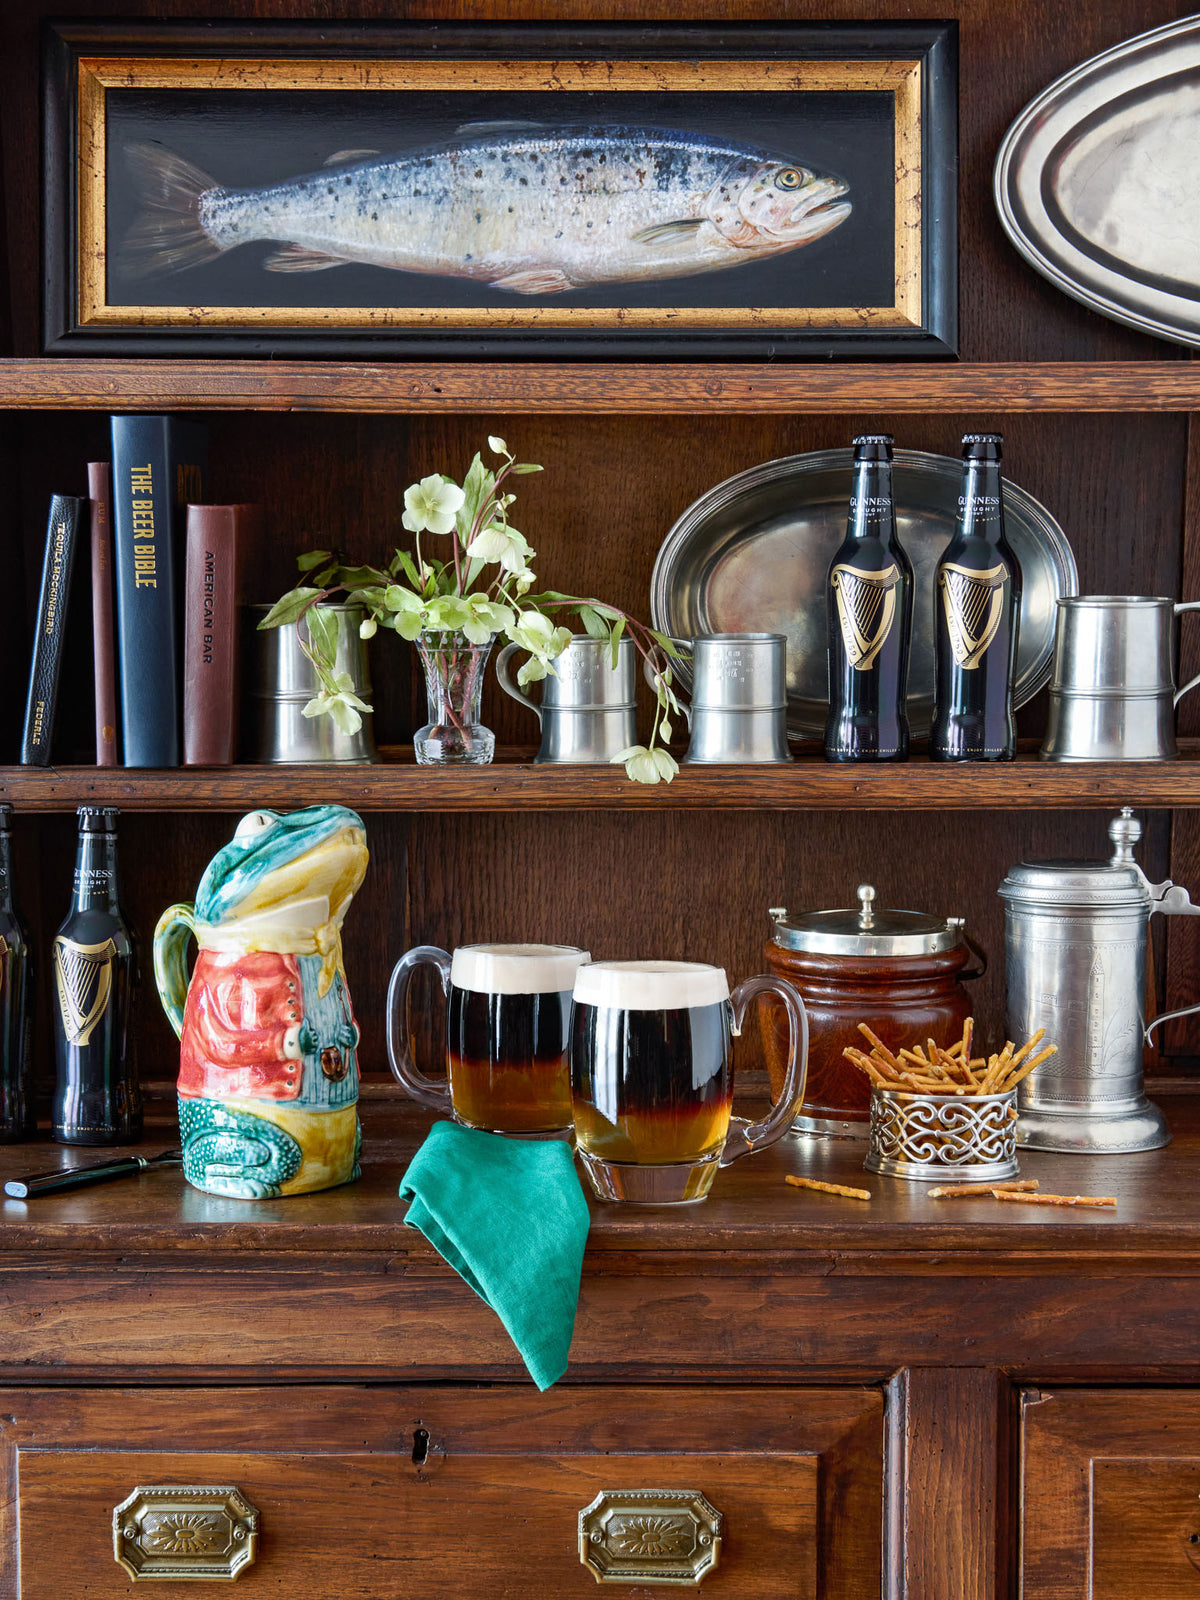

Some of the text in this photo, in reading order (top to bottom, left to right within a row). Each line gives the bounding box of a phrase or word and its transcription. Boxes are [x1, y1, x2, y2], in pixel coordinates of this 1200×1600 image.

[131, 464, 157, 588] THE BEER BIBLE
[850, 496, 892, 506] GUNNESS
[958, 495, 1000, 505] GUNNESS
[46, 522, 66, 635] TEQUILA MOCKINGBIRD
[203, 551, 215, 664] AMERICAN BAR
[32, 700, 45, 745] FEDERLE
